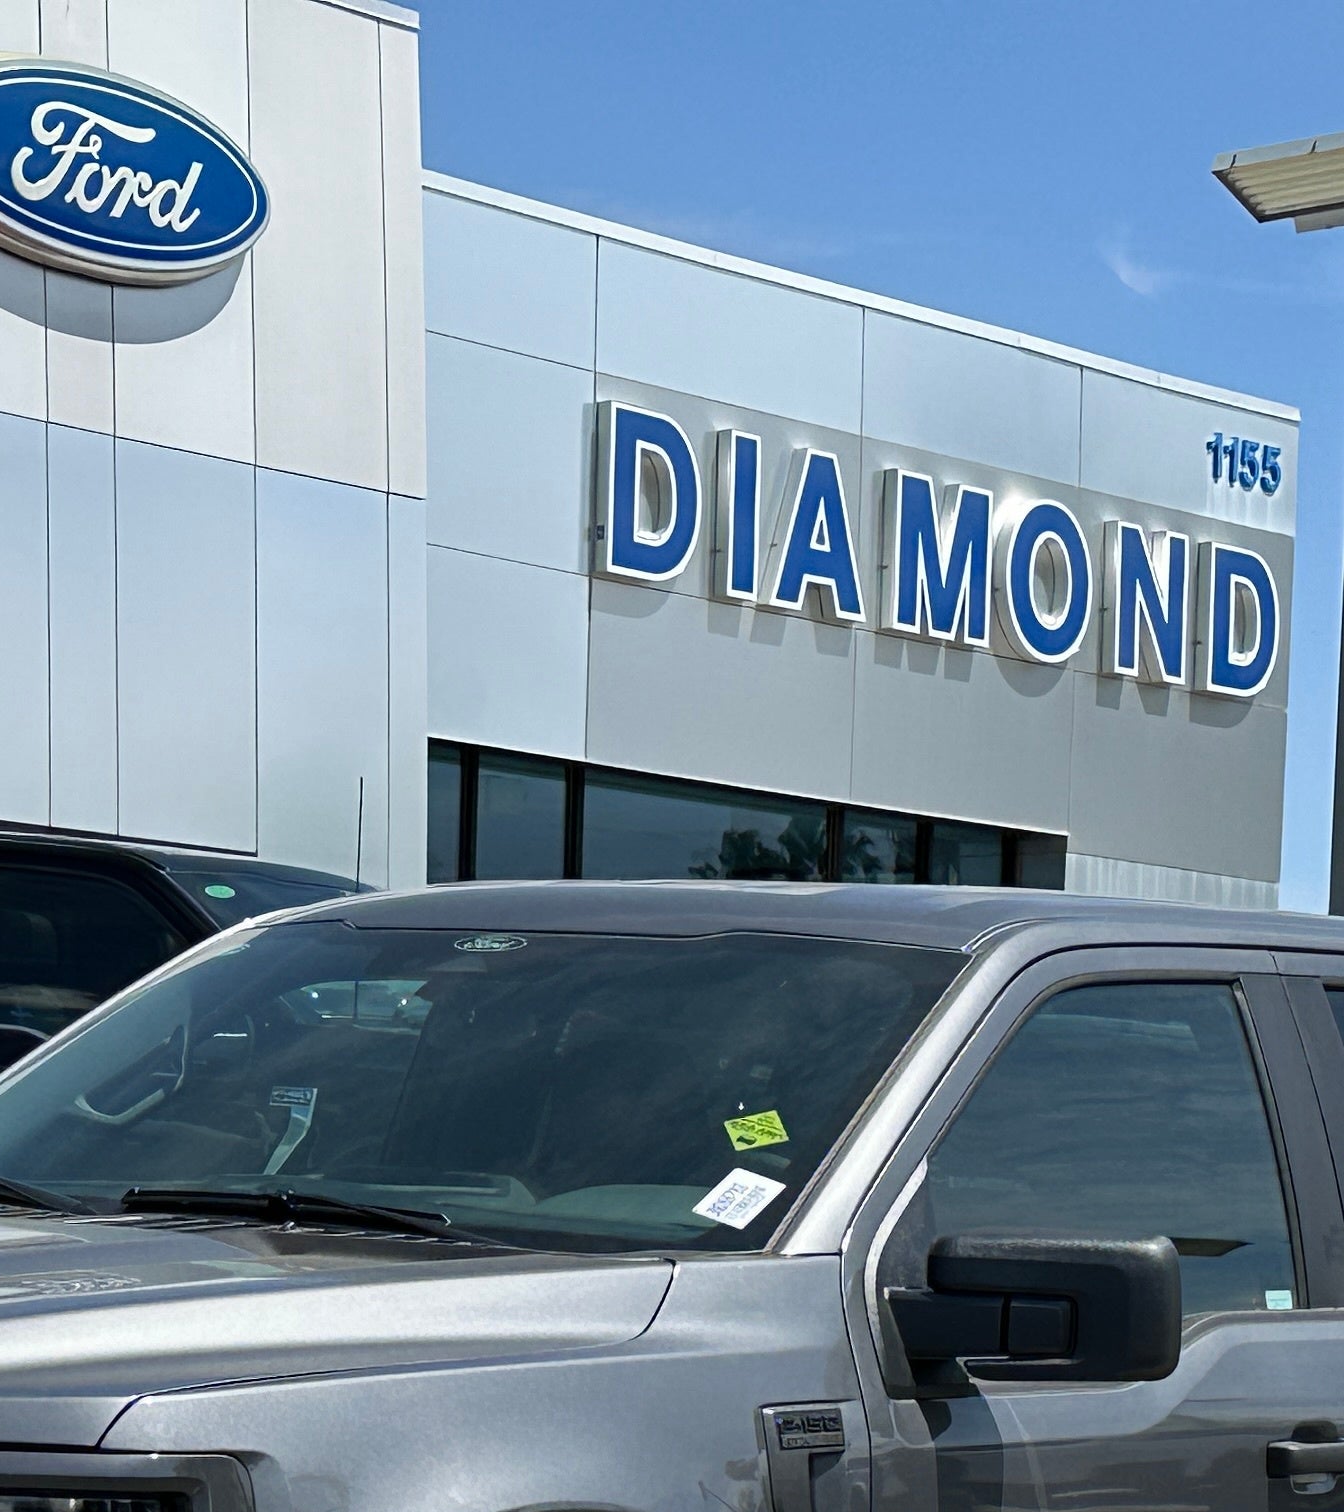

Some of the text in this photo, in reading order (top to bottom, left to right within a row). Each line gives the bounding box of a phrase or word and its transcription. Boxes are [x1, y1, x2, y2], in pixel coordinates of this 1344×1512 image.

[10, 100, 205, 234] Ford
[1206, 432, 1282, 497] 1155
[598, 399, 1281, 699] DIAMOND
